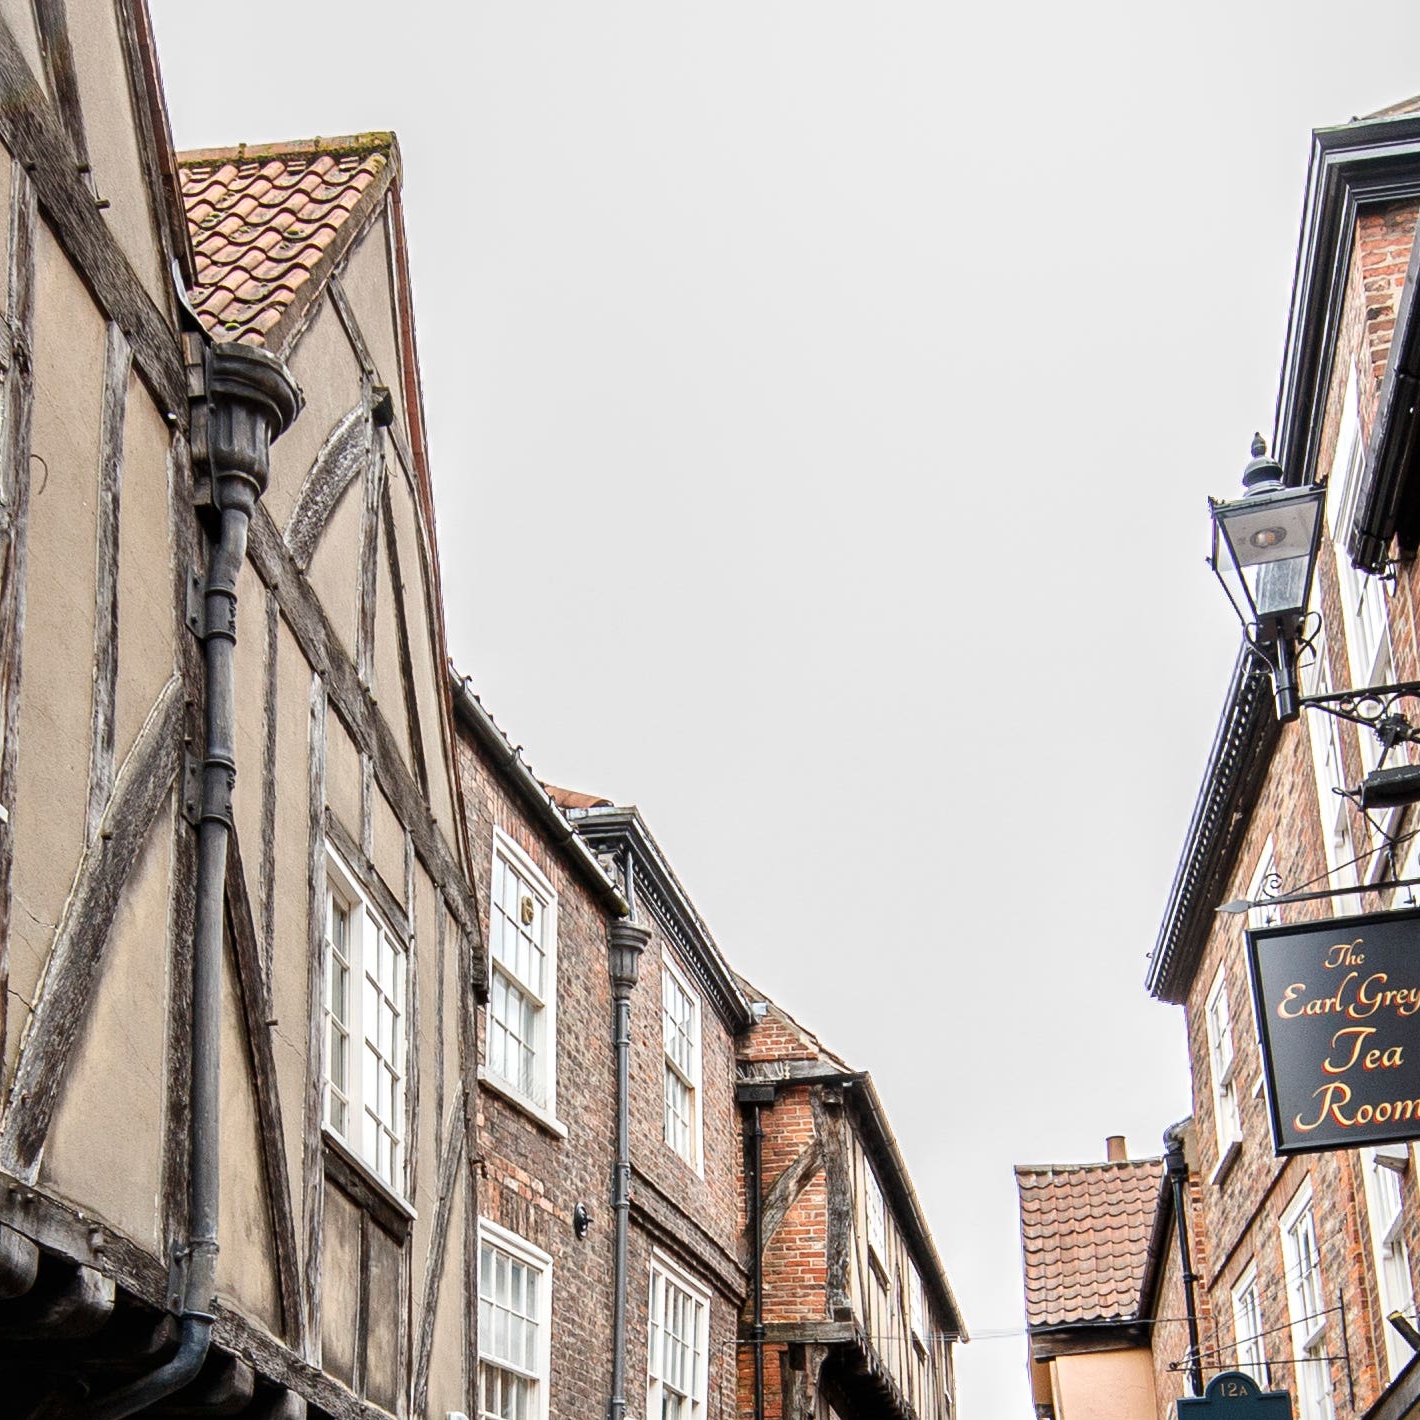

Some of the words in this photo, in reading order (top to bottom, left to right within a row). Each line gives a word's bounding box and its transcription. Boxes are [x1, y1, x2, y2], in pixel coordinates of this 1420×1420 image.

[1323, 939, 1364, 969] The
[1279, 971, 1358, 1019] Earl
[1322, 1026, 1404, 1074] Tea
[1220, 1383, 1248, 1397] 12A
